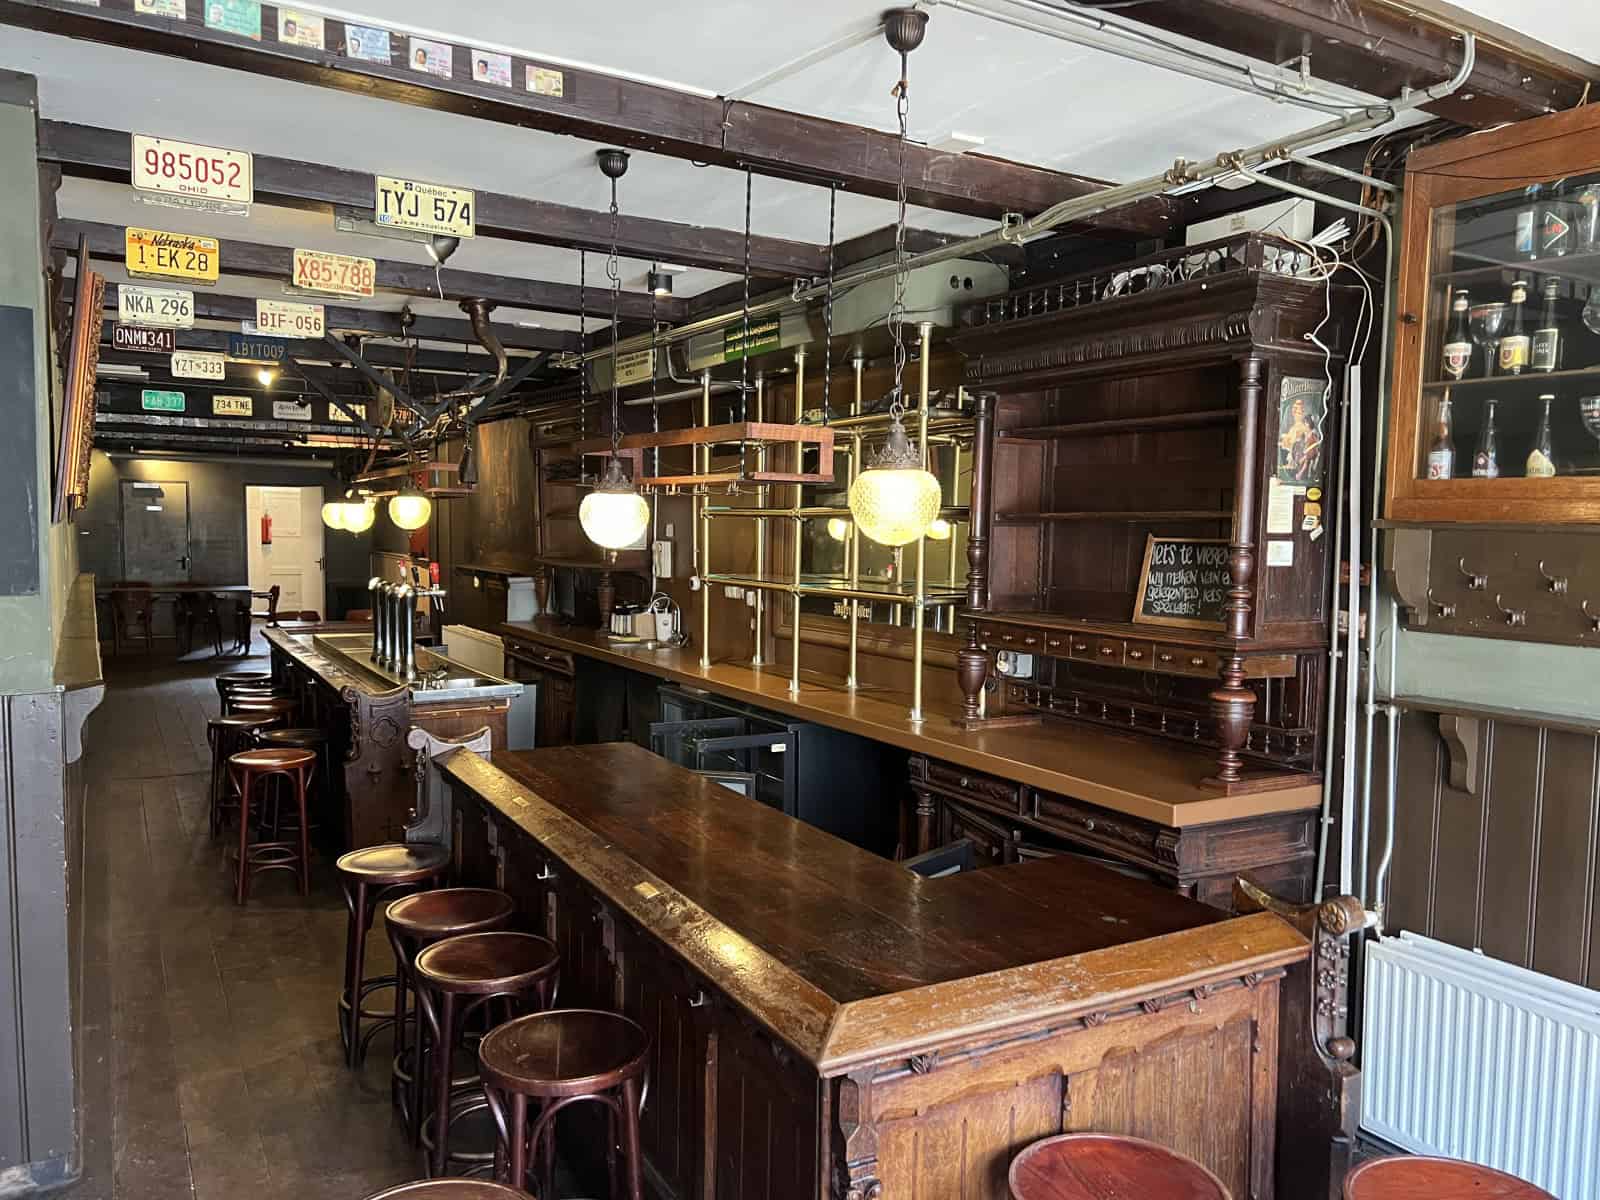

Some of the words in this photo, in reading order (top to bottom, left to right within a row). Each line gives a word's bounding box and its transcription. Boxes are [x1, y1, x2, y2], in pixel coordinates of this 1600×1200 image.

[145, 148, 241, 189] 985052
[178, 184, 208, 194] OHIO
[380, 188, 418, 218] TYJ
[433, 197, 470, 226] 574
[150, 232, 196, 251] Nebraska
[185, 251, 208, 272] 28
[125, 294, 155, 314] NKA
[160, 298, 190, 317] 296
[260, 311, 322, 332] BIF-056
[215, 399, 232, 410] 734
